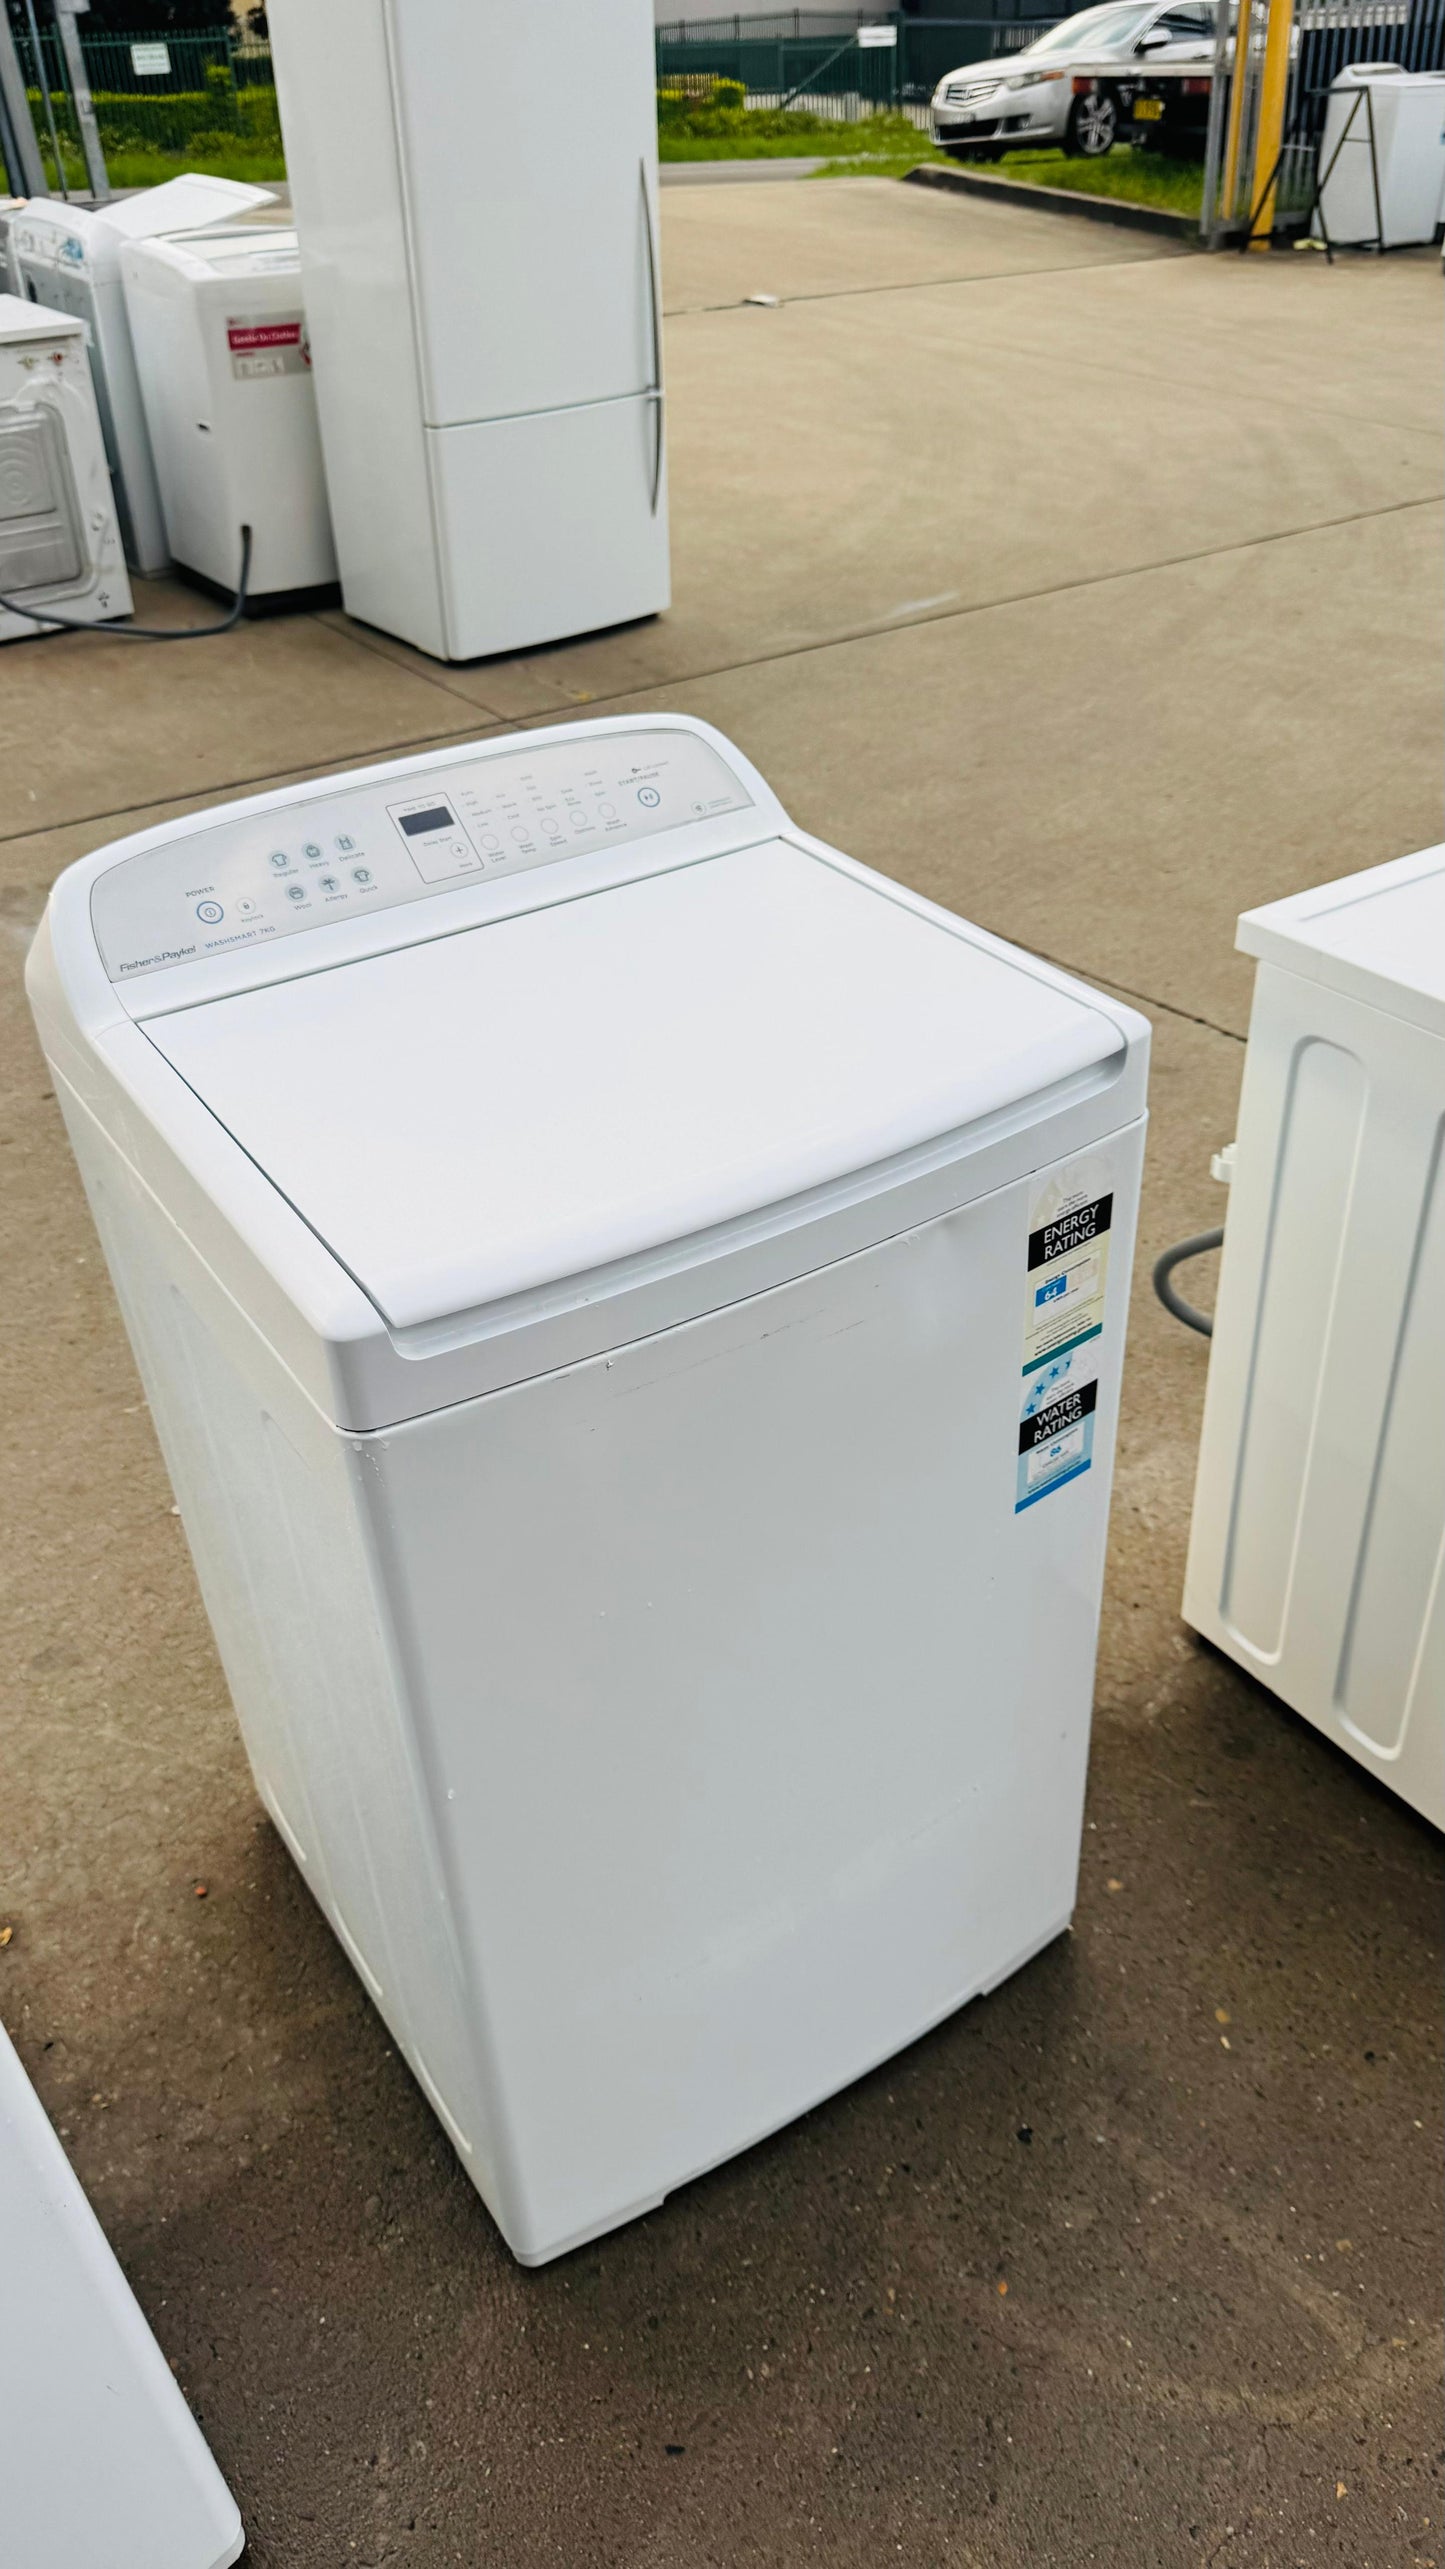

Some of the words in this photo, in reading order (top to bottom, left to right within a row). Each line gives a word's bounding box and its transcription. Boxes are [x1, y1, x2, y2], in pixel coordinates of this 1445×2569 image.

[185, 886, 215, 898] POWER
[359, 884, 379, 894] Quick
[119, 945, 196, 972] Fisher&Paykel
[204, 930, 257, 950] WASHSMART
[258, 926, 276, 936] 7KG
[1044, 1204, 1099, 1244] ENERGY
[1044, 1223, 1096, 1260] RATING
[1033, 1406, 1082, 1443] RATING
[1036, 1393, 1082, 1426] WATER
